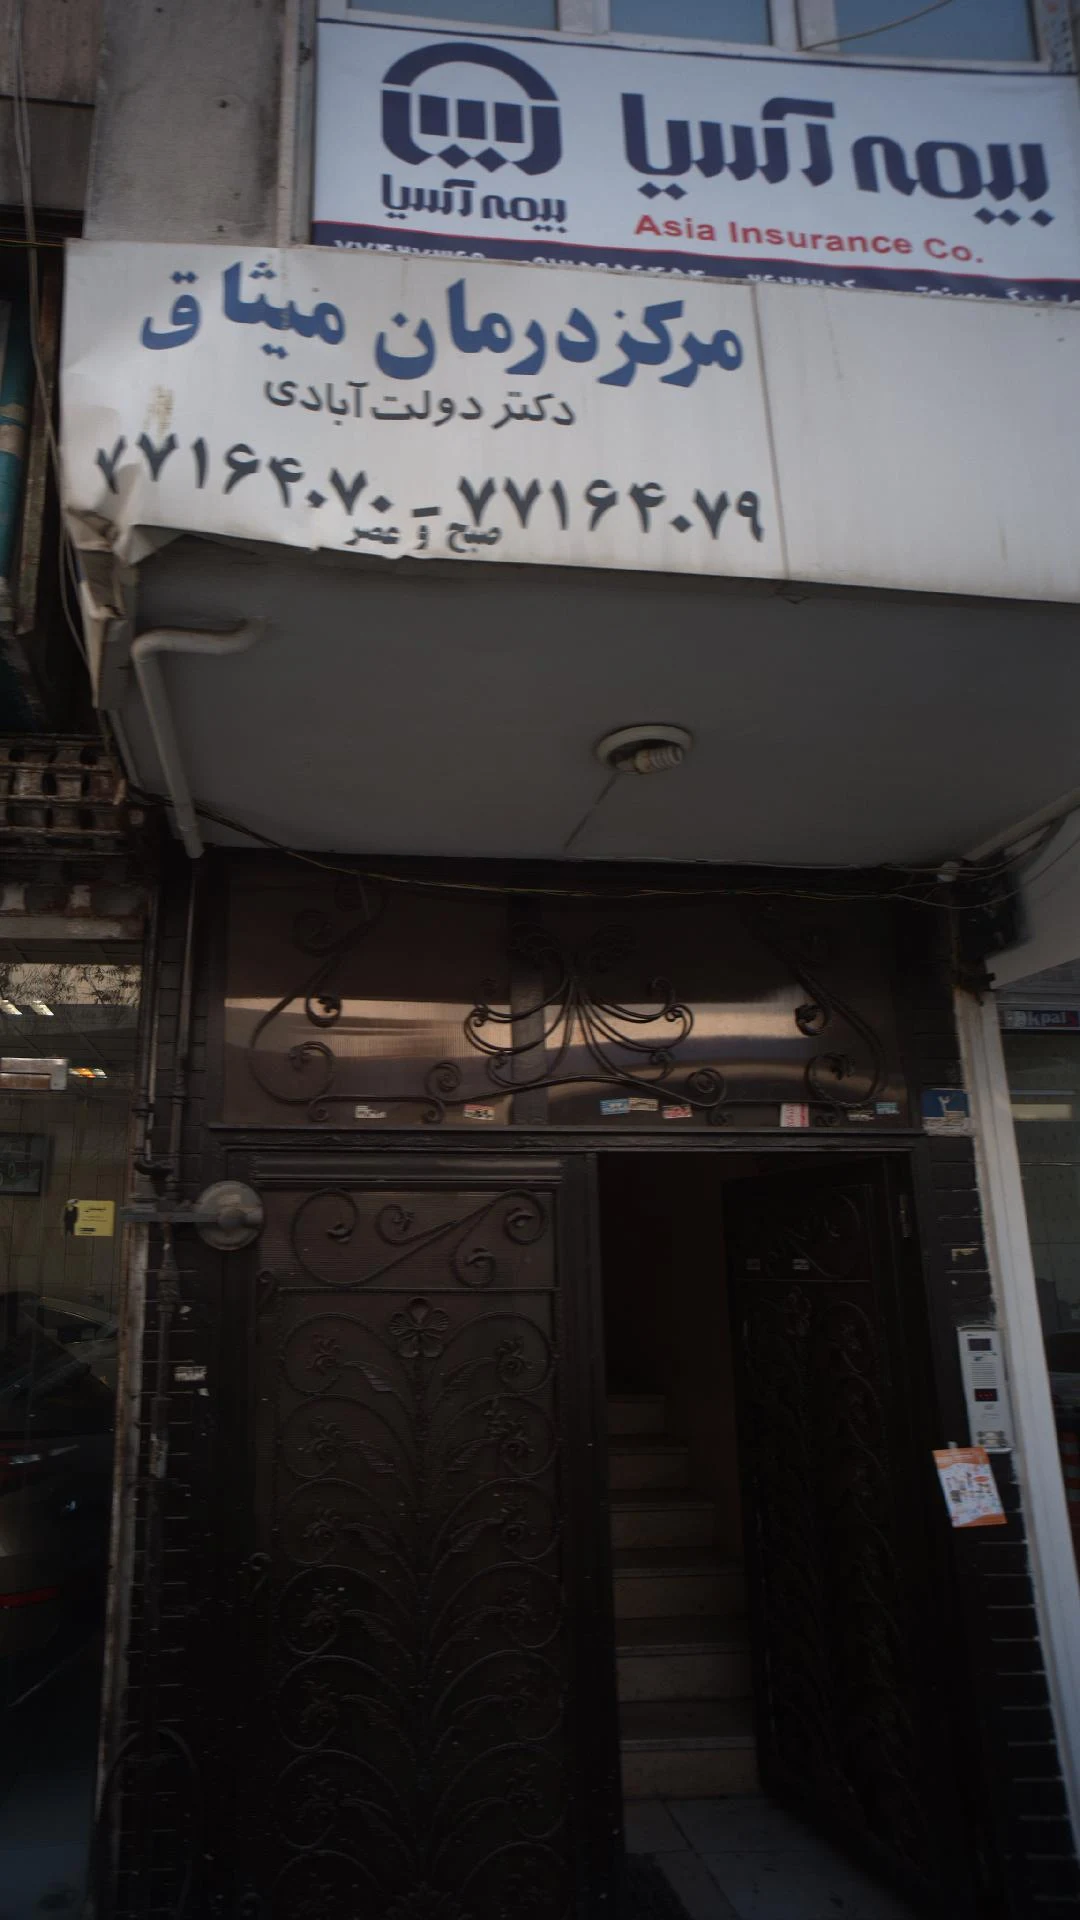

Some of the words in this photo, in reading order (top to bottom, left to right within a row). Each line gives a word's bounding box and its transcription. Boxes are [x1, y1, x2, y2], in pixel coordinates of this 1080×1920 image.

[620, 92, 837, 201] آسیا
[381, 173, 476, 220] آسیا
[850, 134, 1056, 228] بیمه
[480, 194, 568, 234] بیمه
[634, 214, 716, 243] Asia
[728, 221, 912, 255] Insurance
[924, 236, 985, 264] Co.
[140, 261, 346, 358] میثاق
[264, 380, 369, 426] آبادی
[371, 389, 483, 427] دولت
[492, 391, 577, 430] دکتر
[95, 432, 393, 517] ۷۷۱۶۴۰۷۰
[458, 476, 764, 543] ۷۷۱۶۴۰۷۹
[345, 526, 400, 547] عصر
[447, 521, 502, 554] صبح
